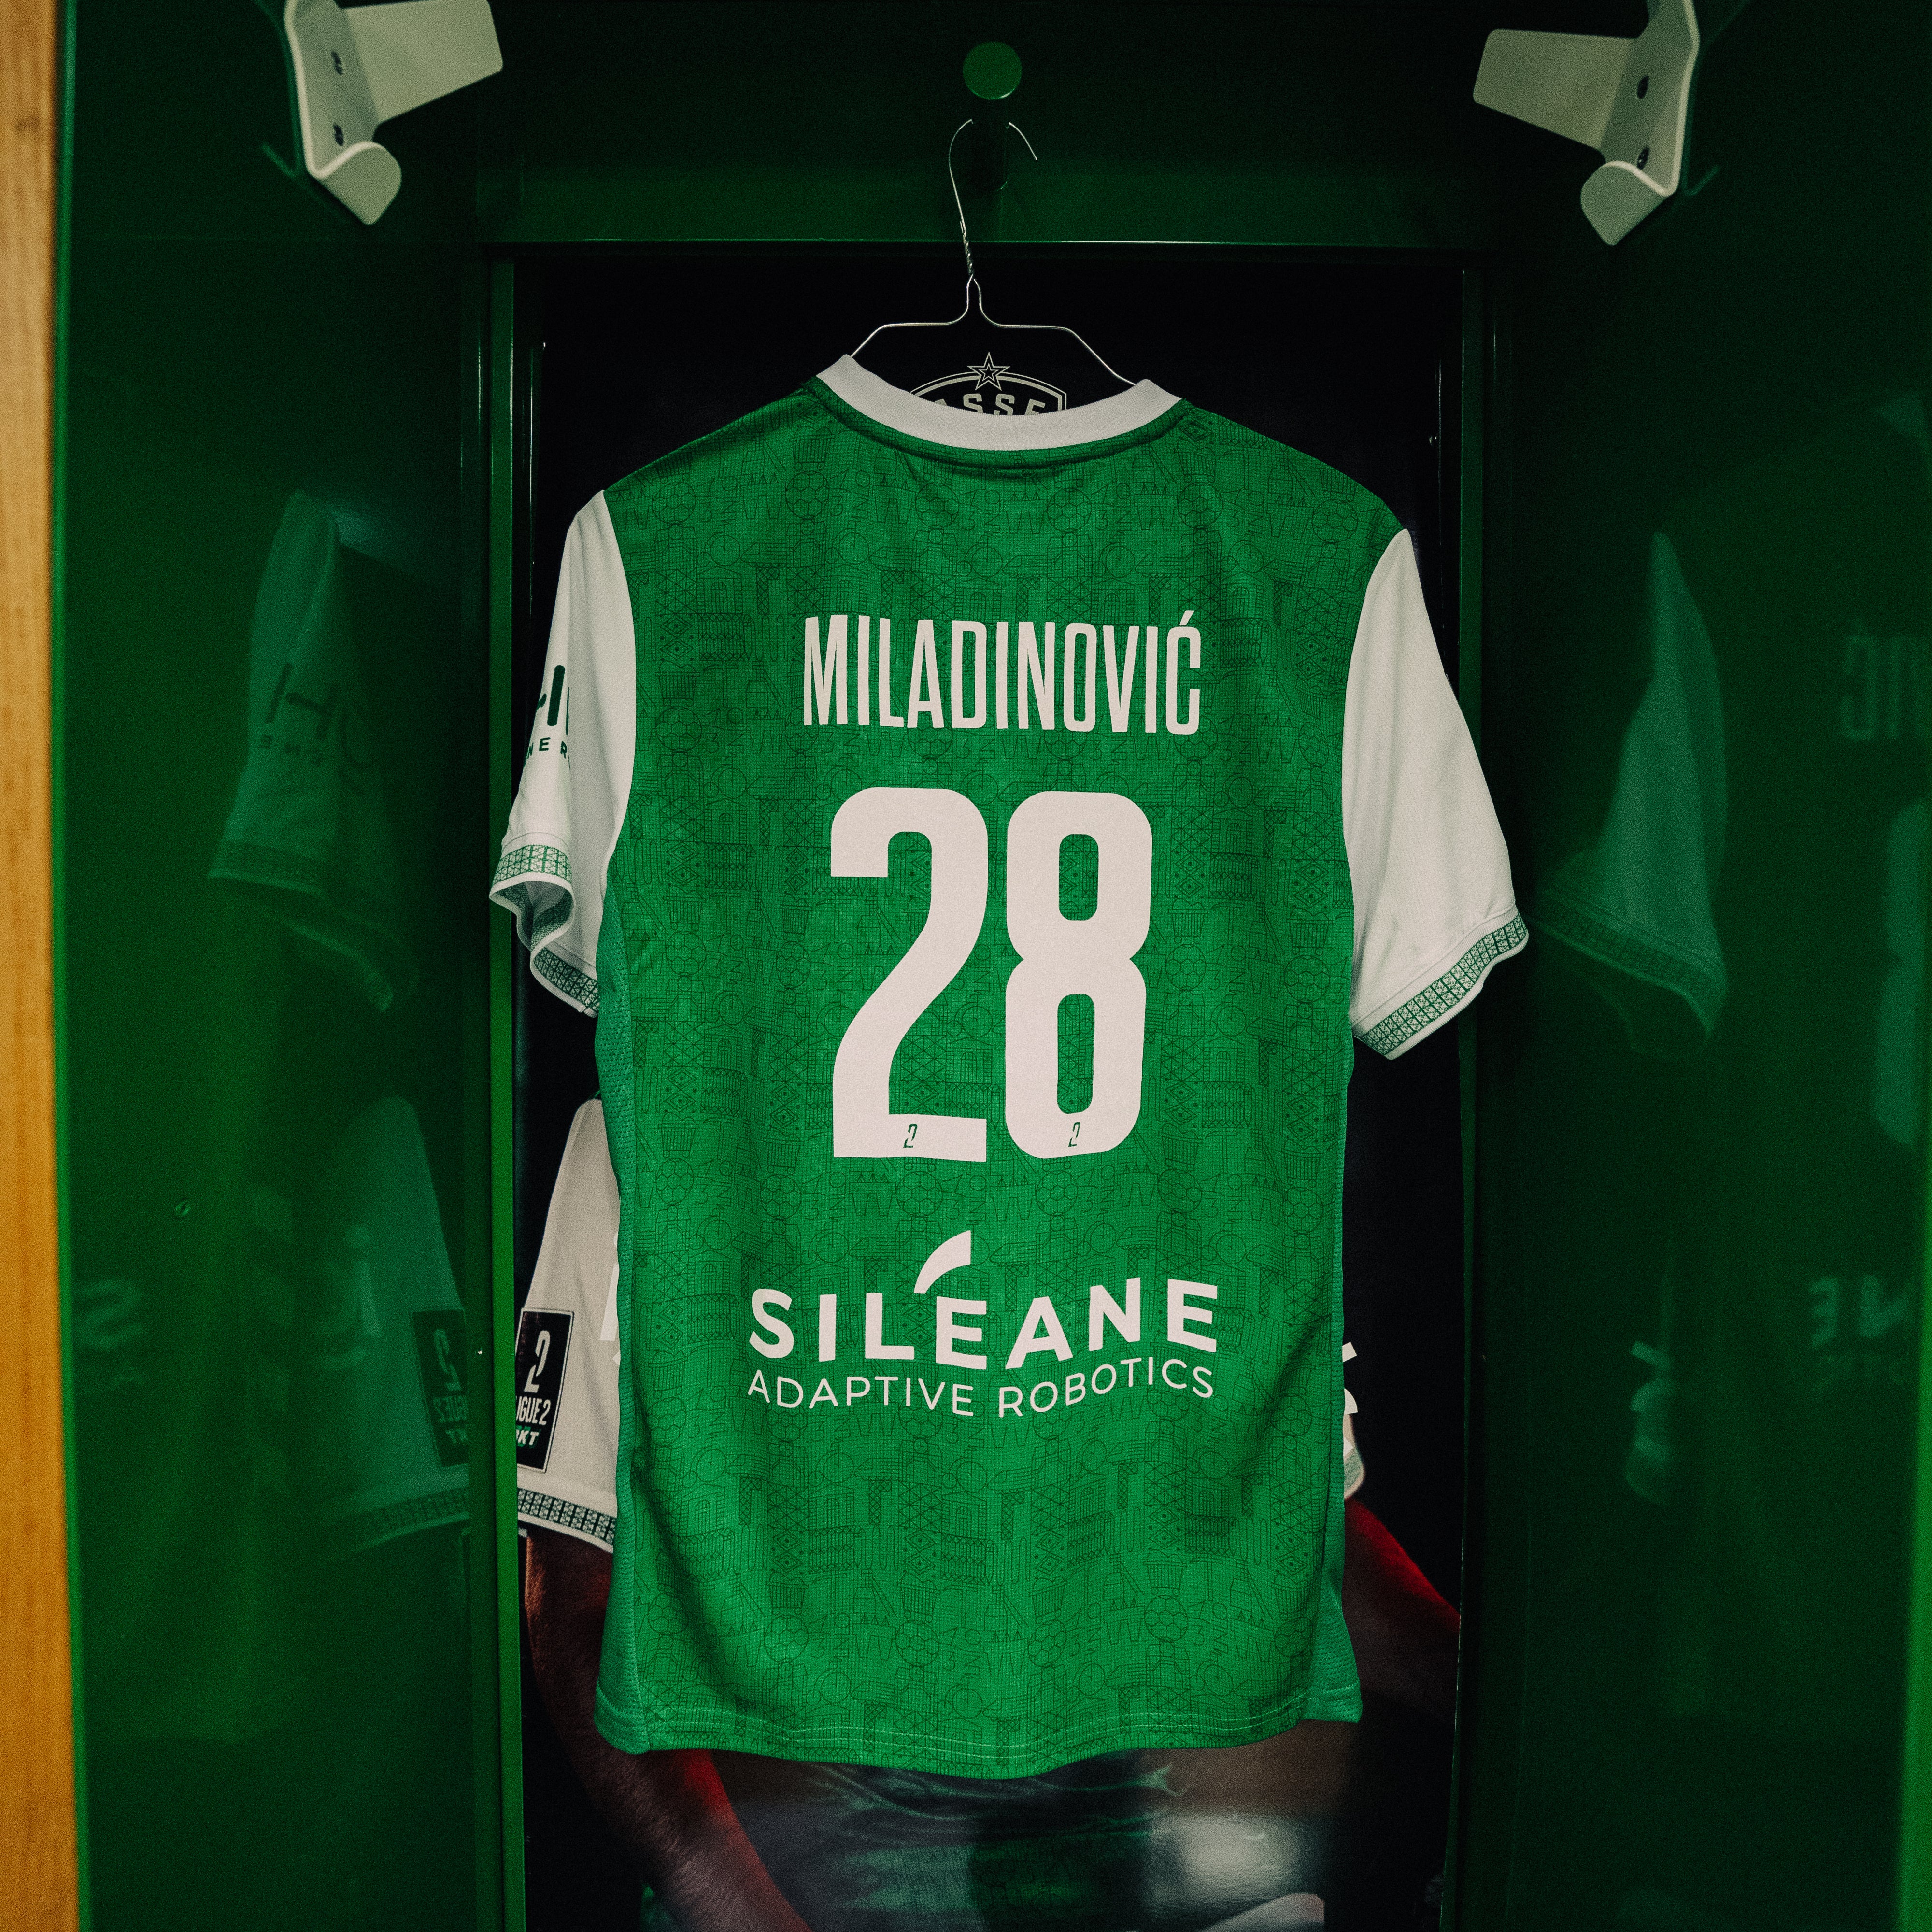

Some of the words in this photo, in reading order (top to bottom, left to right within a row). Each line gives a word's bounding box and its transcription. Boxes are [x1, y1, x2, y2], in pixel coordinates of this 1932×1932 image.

[803, 610, 1201, 735] MILADINOVIĆ
[830, 786, 1153, 1163] 28
[903, 1123, 918, 1149] 2
[1068, 1122, 1081, 1147] 2
[749, 1230, 1218, 1370] SILÉANE
[524, 1330, 550, 1393] 2
[748, 1369, 974, 1417] ADAPTIVE
[998, 1356, 1213, 1418] ROBOTICS
[515, 1395, 551, 1425] IGUE2
